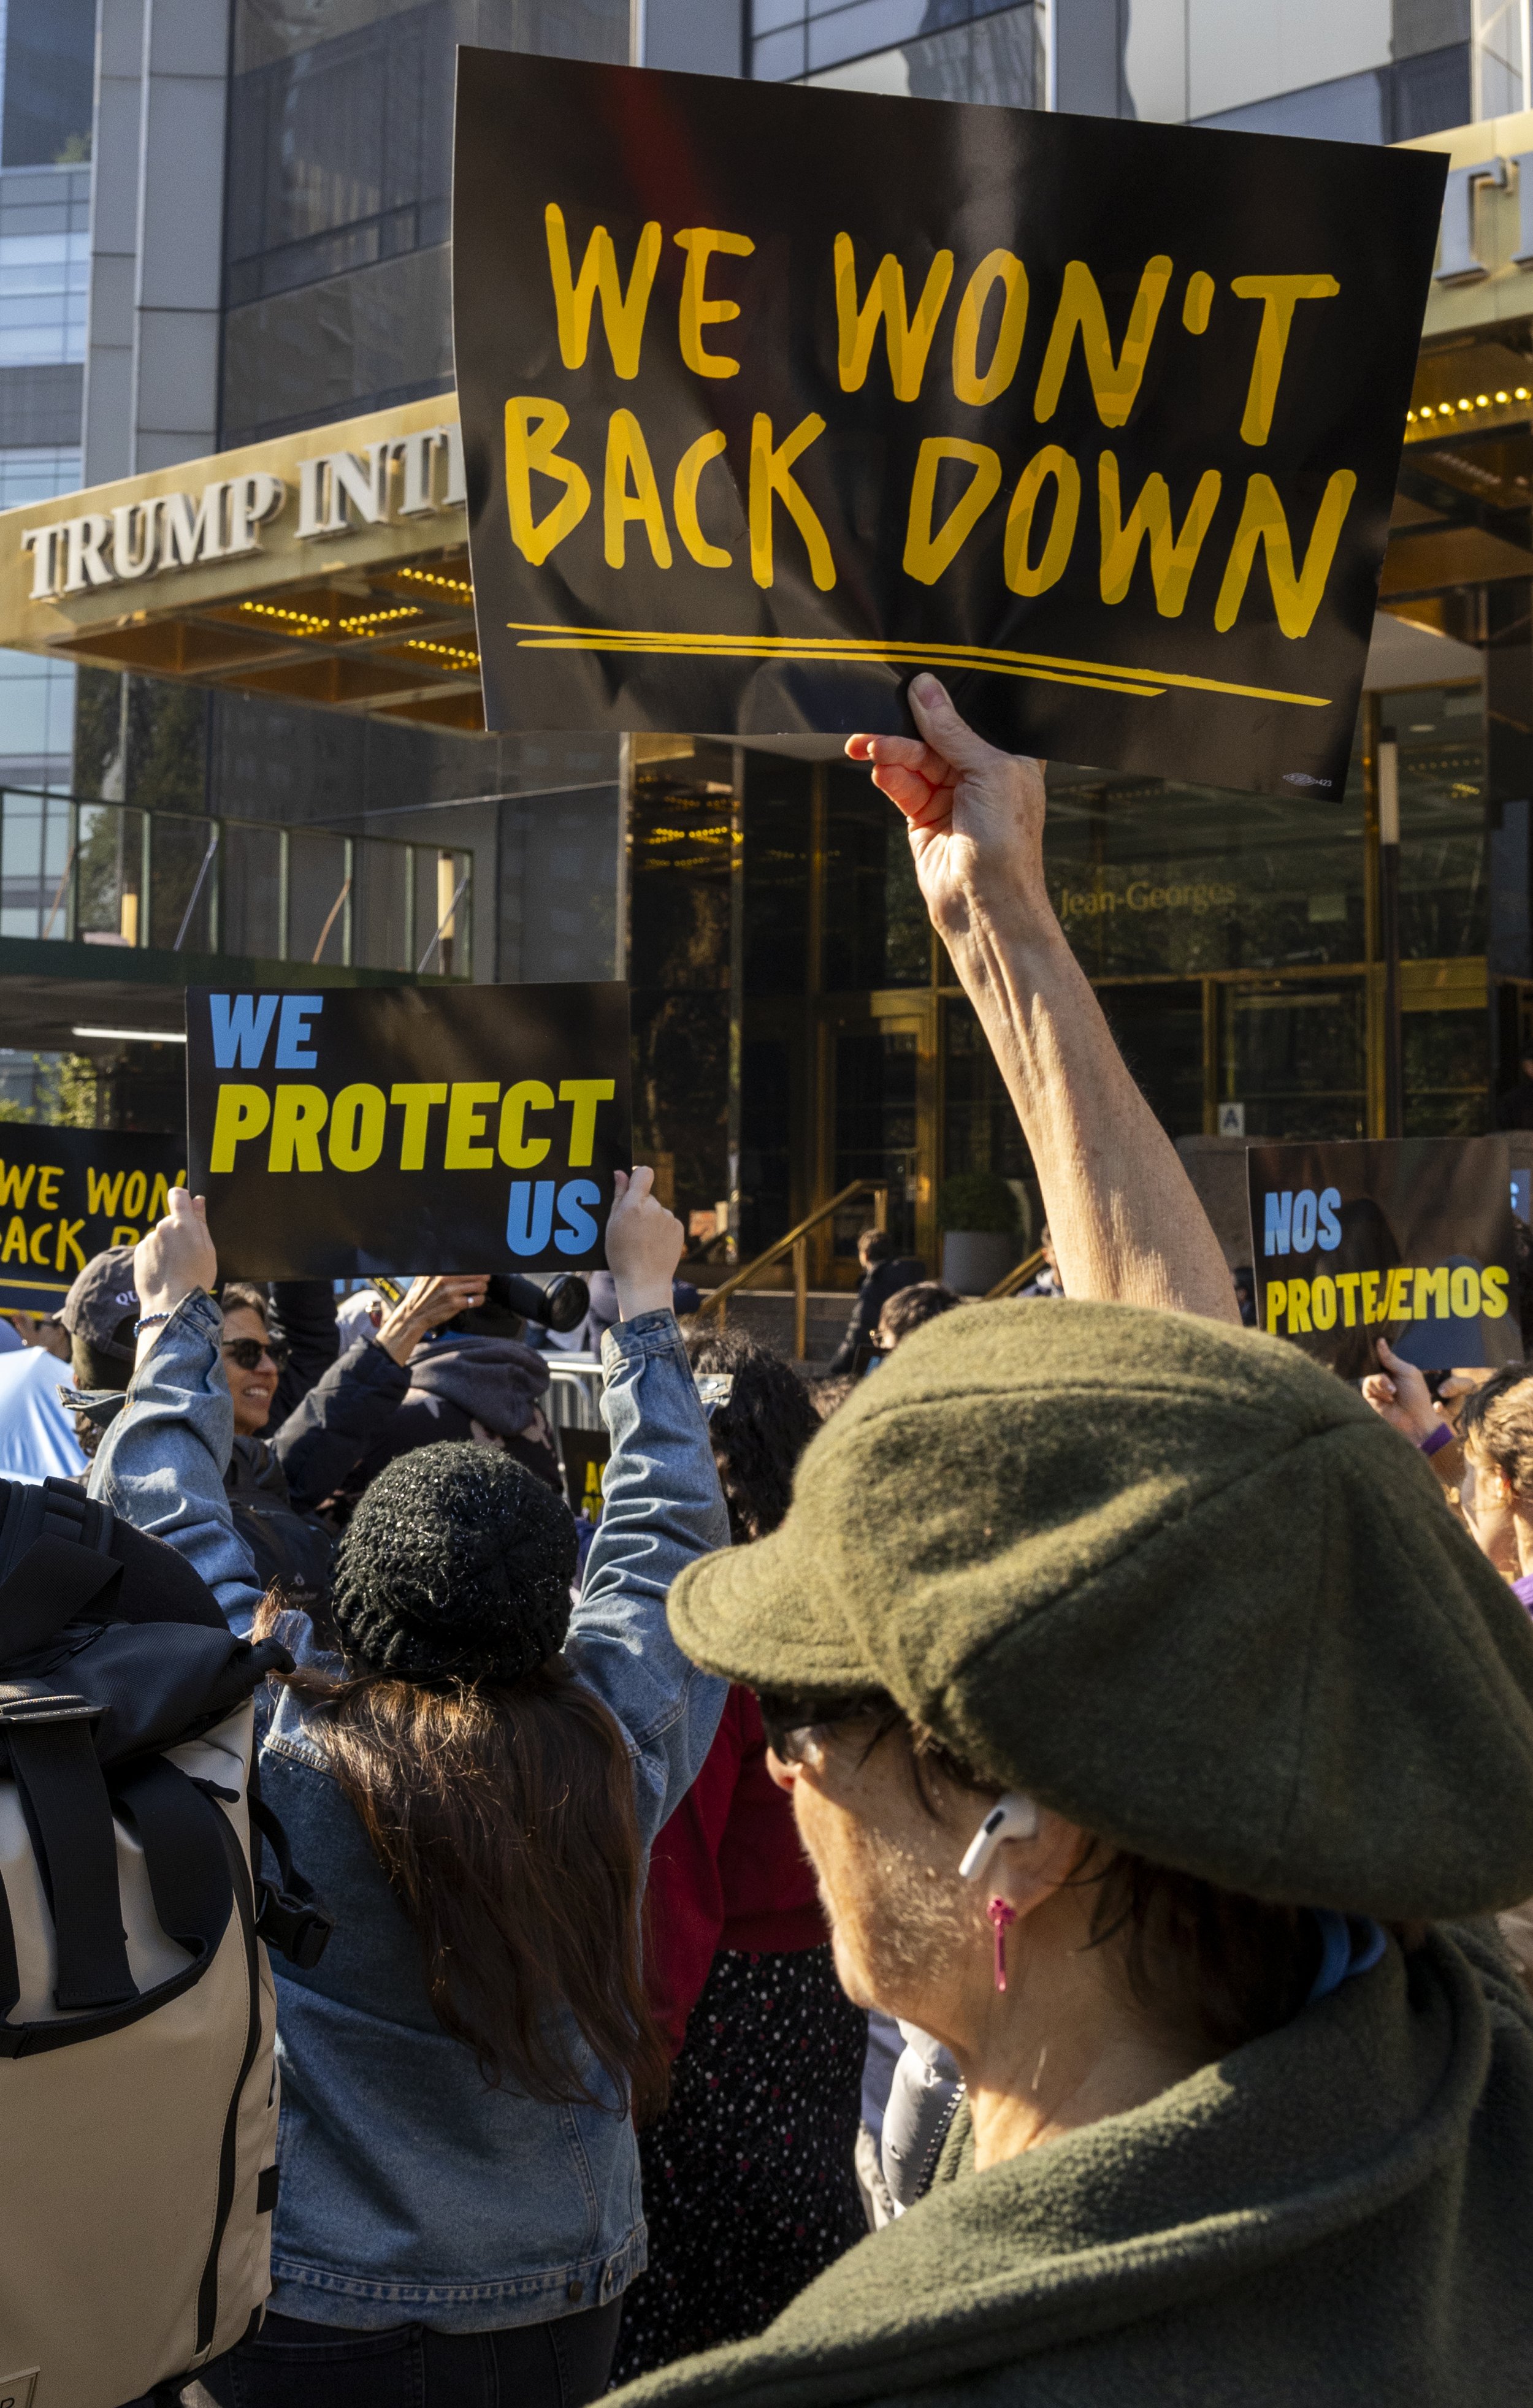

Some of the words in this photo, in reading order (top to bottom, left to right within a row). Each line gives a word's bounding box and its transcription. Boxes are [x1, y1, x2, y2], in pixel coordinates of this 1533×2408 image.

[545, 202, 755, 380] WE
[834, 231, 1341, 446] WON'T
[21, 472, 287, 602] TRUMP
[505, 396, 836, 592] BACK
[903, 436, 1357, 639] DOWN
[1061, 880, 1237, 920] Jean-Georges
[209, 994, 324, 1069] WE
[209, 1079, 616, 1173] PROTECT
[1224, 1108, 1239, 1128] A
[0, 1216, 86, 1273] ACK
[506, 1179, 602, 1257] US
[1264, 1186, 1343, 1257] NOS
[1266, 1265, 1510, 1336] PROTEJEMOS
